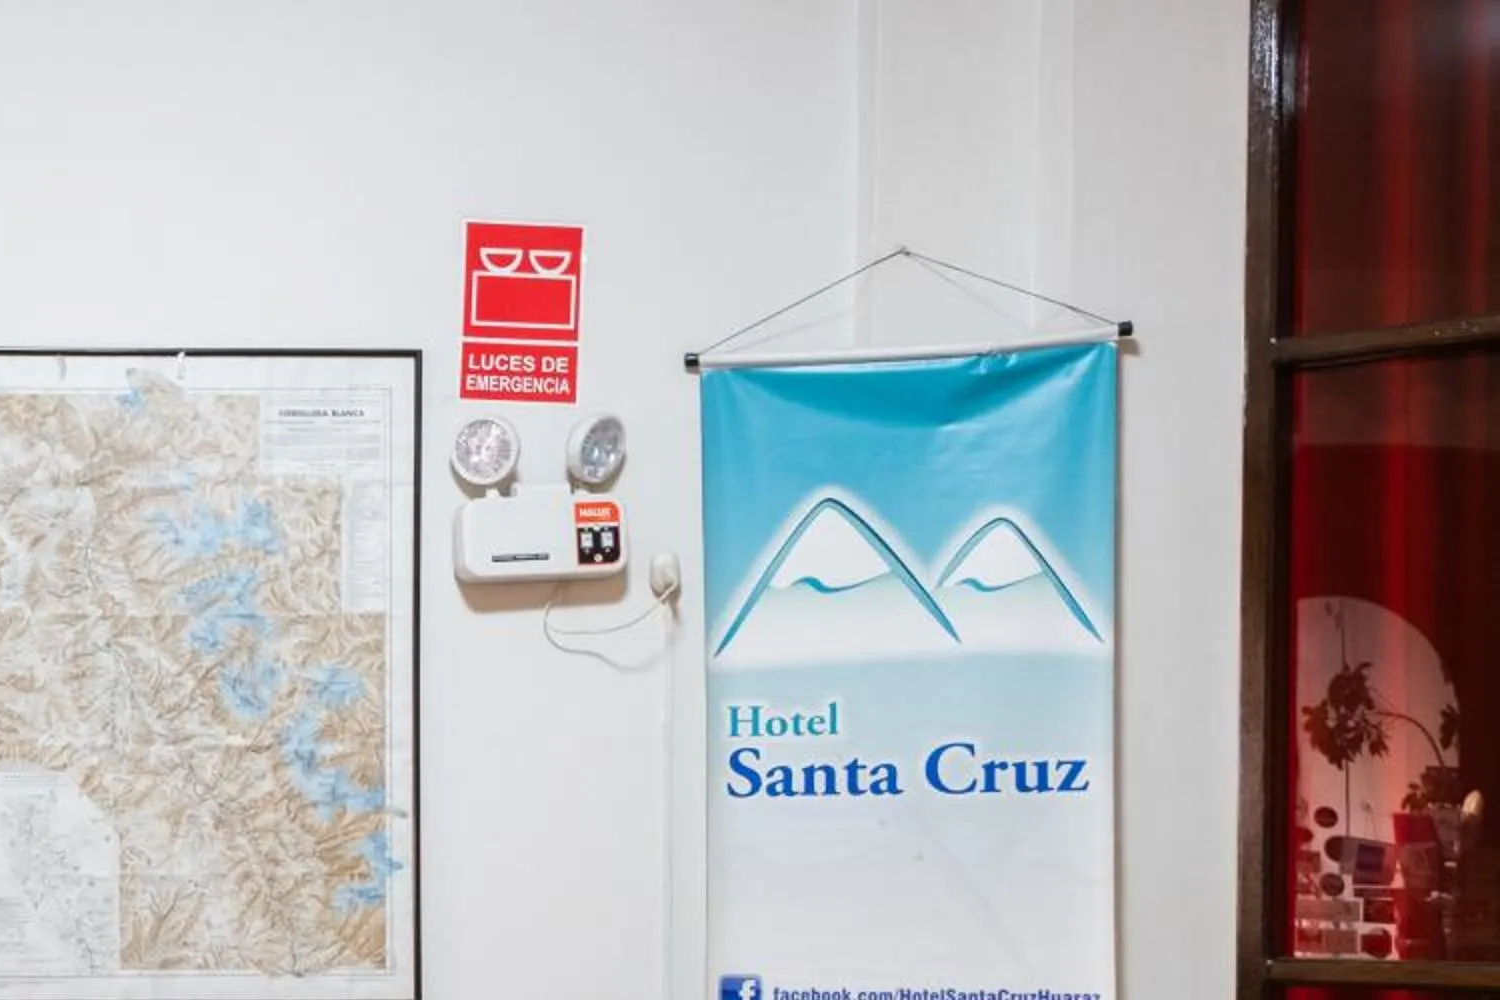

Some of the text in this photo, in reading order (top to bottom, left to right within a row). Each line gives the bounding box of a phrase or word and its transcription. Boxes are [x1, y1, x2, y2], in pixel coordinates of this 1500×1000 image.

[468, 354, 569, 374] LUCES DE
[466, 374, 570, 394] EMERGENCIA
[727, 701, 838, 737] Hotel
[727, 742, 1090, 798] Santa Cruz
